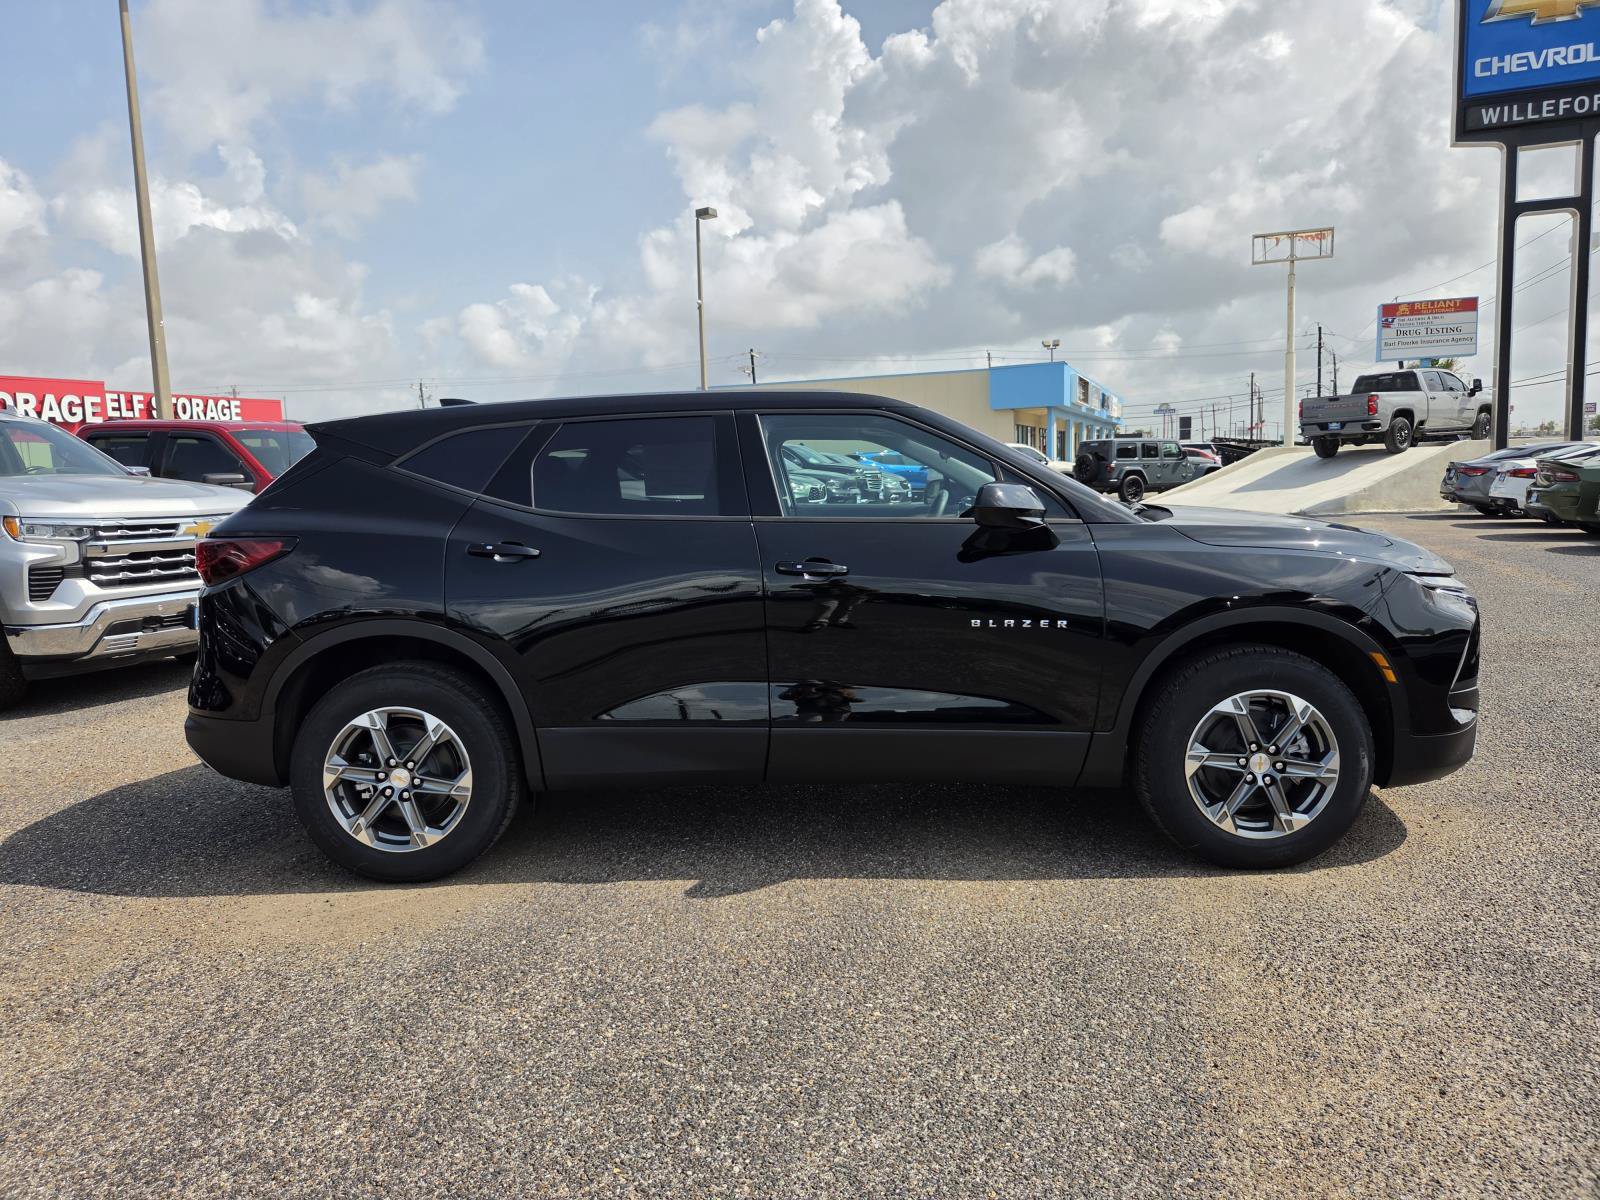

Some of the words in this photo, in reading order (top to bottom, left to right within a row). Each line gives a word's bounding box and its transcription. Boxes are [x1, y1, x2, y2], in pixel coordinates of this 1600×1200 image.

[1474, 42, 1600, 77] CHEVROL
[1414, 299, 1462, 310] RELIANT
[1396, 328, 1421, 337] DRUG
[1425, 325, 1462, 335] TESTING
[970, 619, 1068, 629] BLAZER
